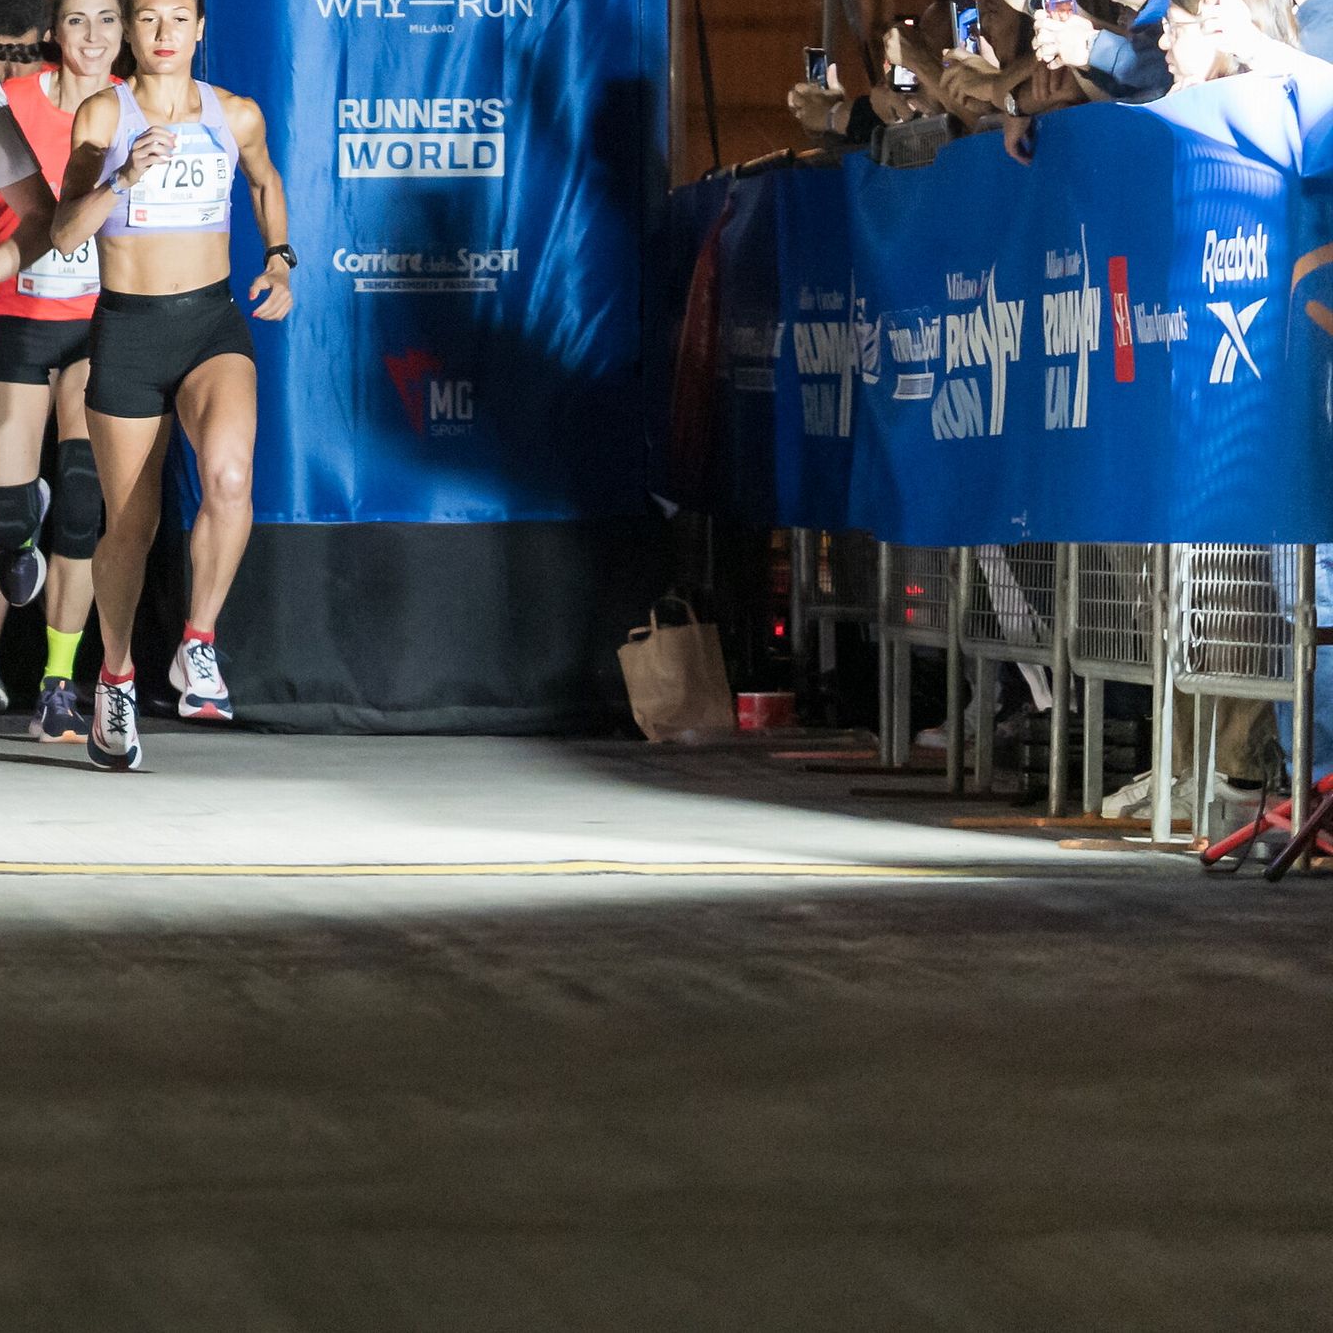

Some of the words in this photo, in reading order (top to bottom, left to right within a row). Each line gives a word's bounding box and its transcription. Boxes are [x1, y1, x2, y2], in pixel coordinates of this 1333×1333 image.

[409, 24, 455, 34] MILANO
[346, 141, 499, 171] WORLD
[161, 158, 204, 188] 726
[333, 247, 423, 273] Corriere
[457, 247, 519, 279] Sport
[1202, 223, 1269, 294] Reebok
[1113, 292, 1133, 348] SEA
[430, 380, 474, 420] MG
